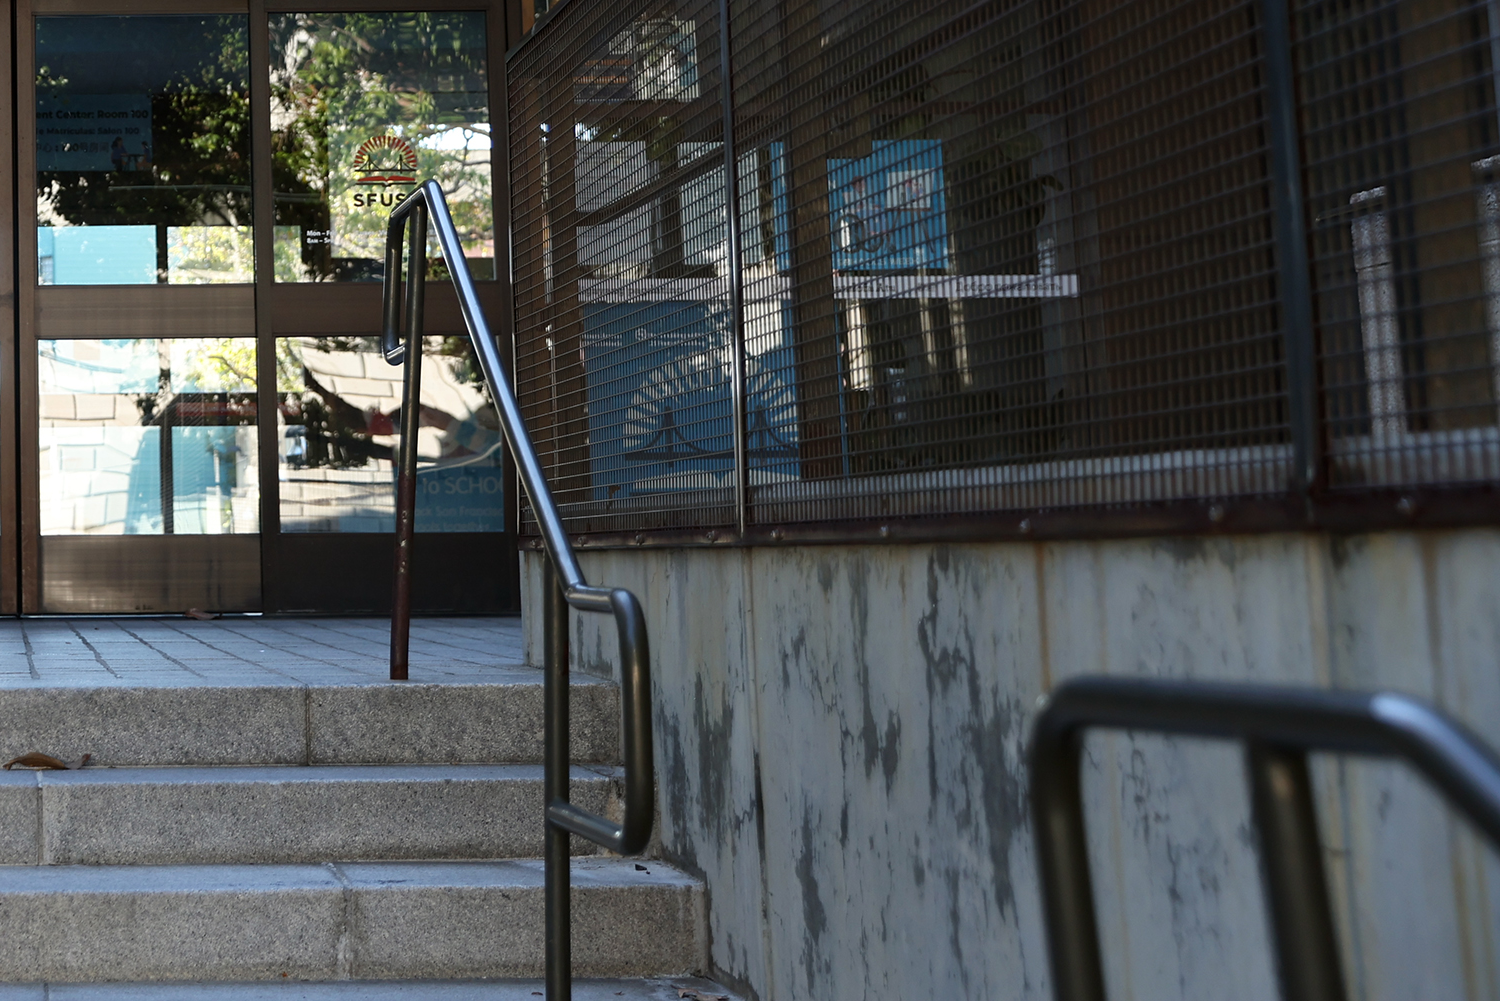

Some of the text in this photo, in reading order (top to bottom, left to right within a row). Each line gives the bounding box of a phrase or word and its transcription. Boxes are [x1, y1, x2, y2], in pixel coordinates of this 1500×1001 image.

[56, 110, 94, 119] Center:
[97, 110, 128, 119] Room
[131, 110, 149, 119] 100
[125, 127, 140, 135] 100
[354, 193, 406, 208] SFUS
